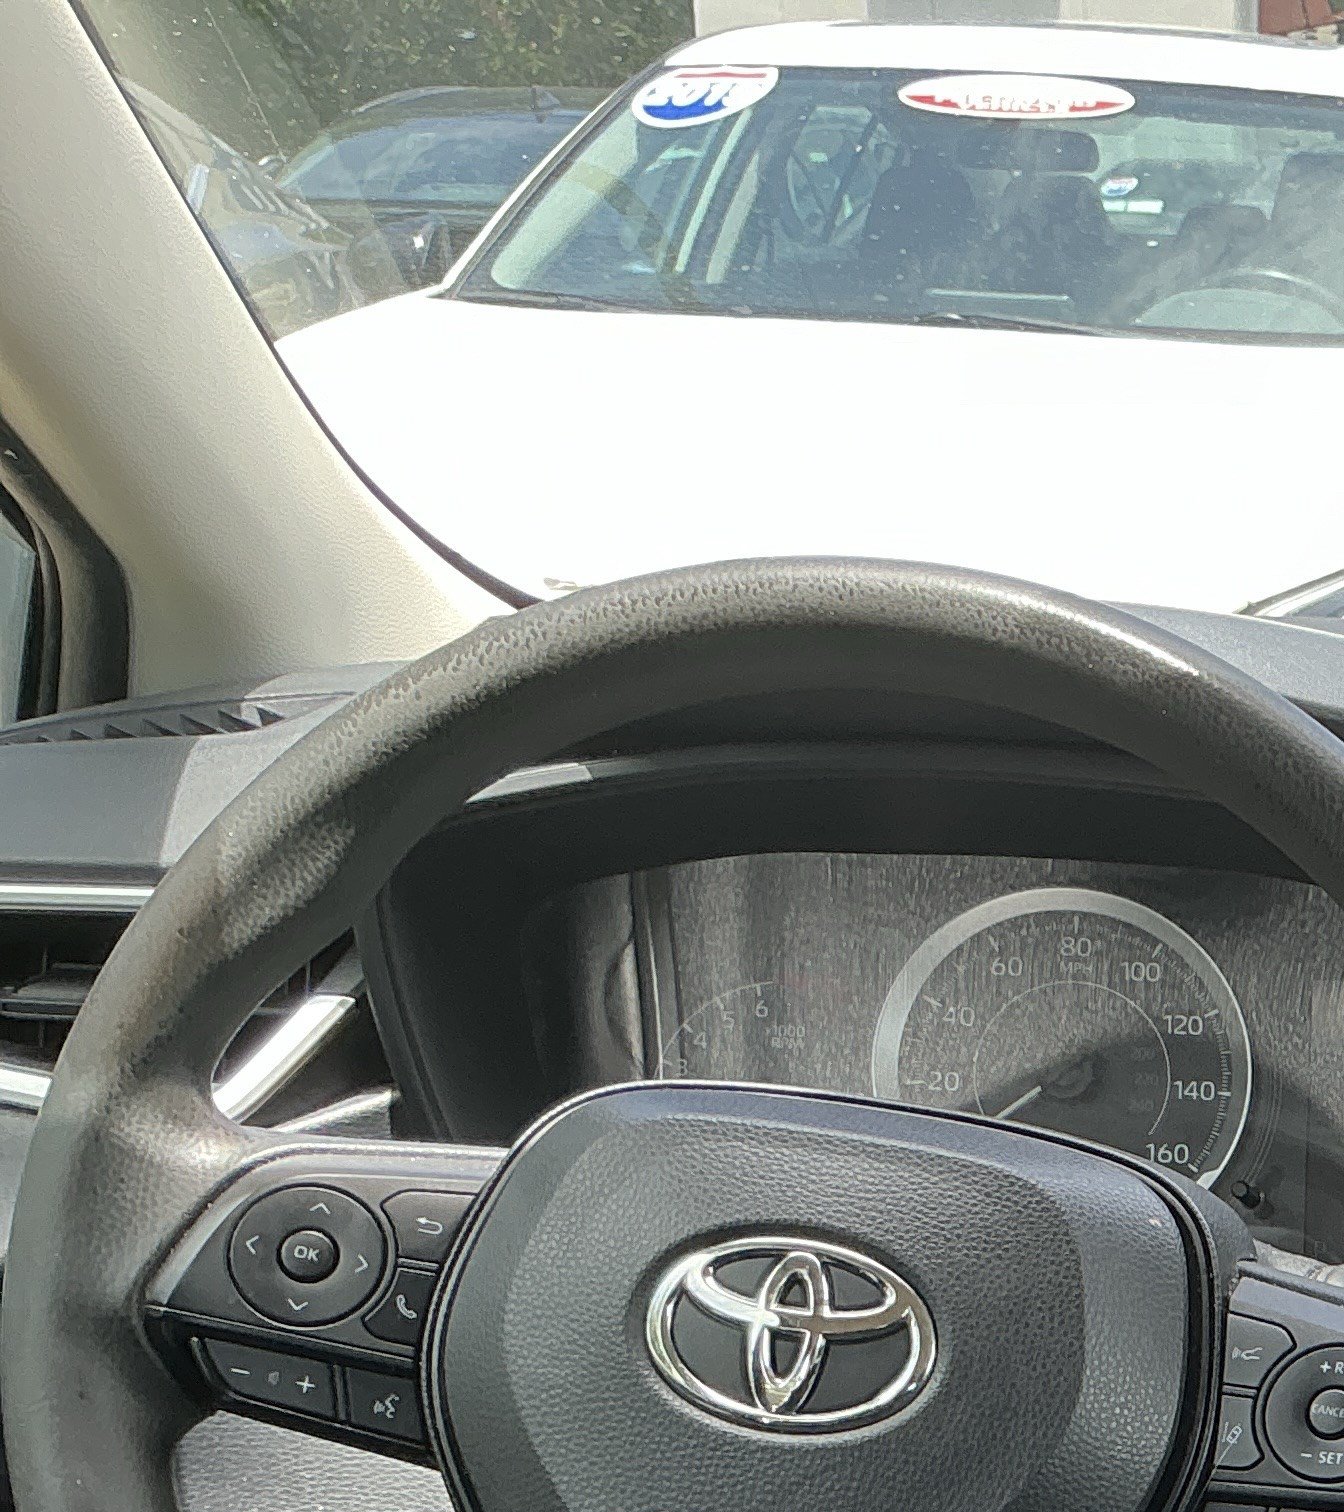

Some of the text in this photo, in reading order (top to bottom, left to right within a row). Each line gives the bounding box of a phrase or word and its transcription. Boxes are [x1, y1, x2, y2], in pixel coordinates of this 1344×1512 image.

[1060, 937, 1092, 959] 80
[992, 956, 1162, 983] 60 100
[1060, 960, 1093, 974] MPH
[755, 1000, 769, 1018] 6
[943, 1006, 976, 1029] 40
[1164, 1014, 1204, 1036] 120
[928, 1071, 960, 1093] 20
[1173, 1080, 1216, 1101] 140
[1147, 1143, 1190, 1165] 160
[293, 1245, 320, 1262] OK
